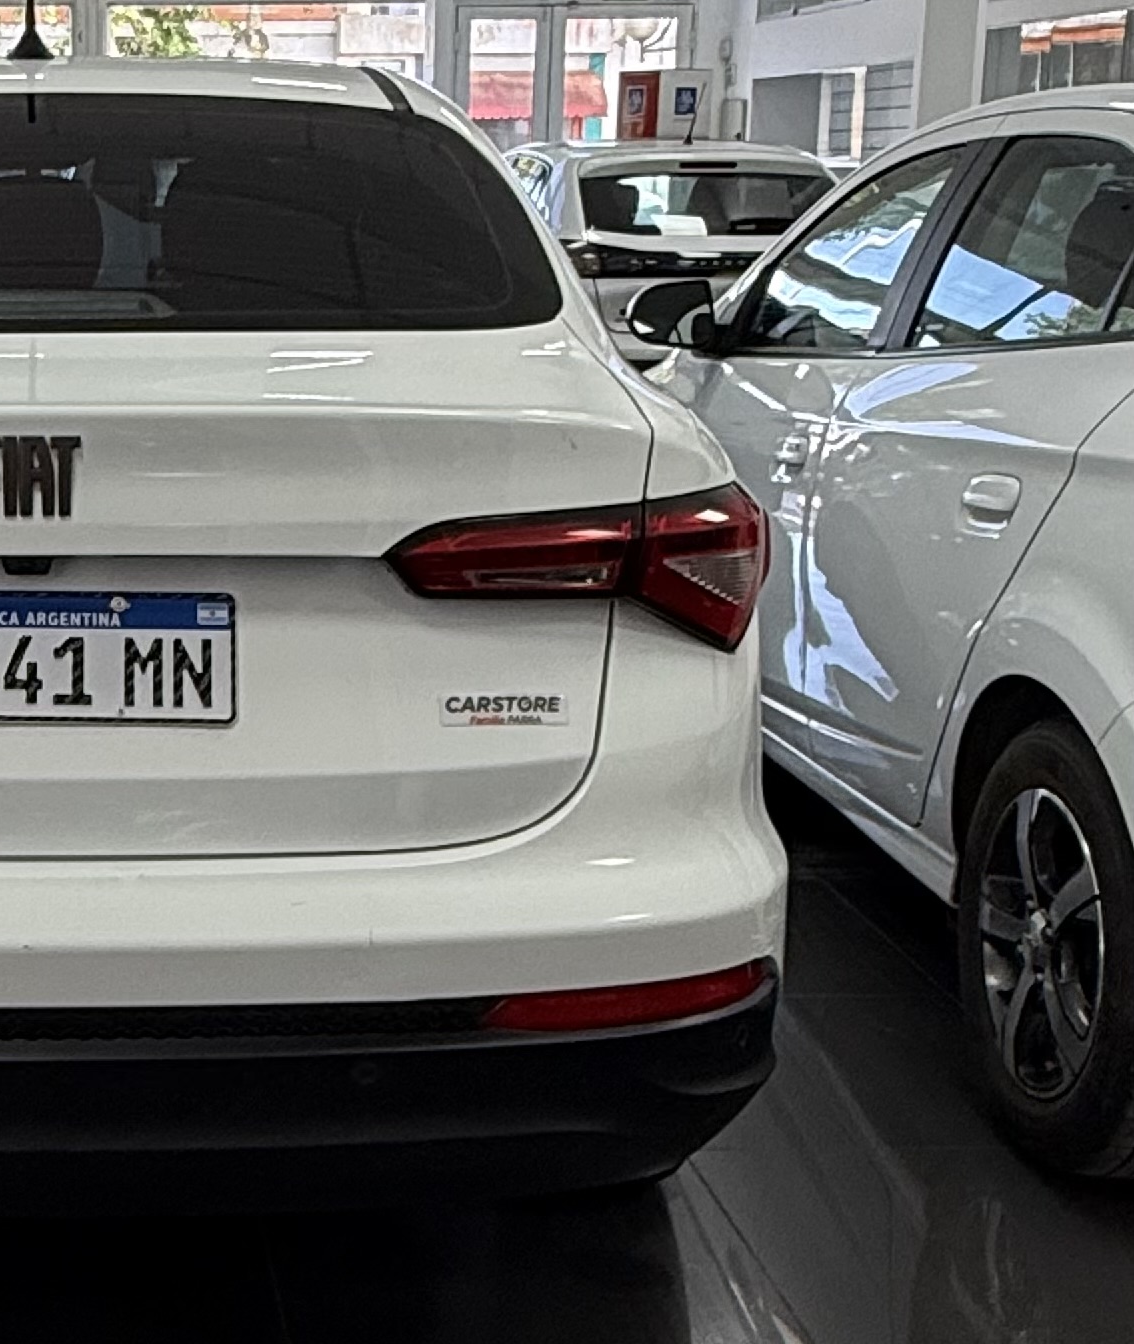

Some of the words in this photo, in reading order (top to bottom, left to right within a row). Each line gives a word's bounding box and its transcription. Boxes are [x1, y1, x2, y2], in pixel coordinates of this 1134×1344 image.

[25, 611, 121, 627] ARGENTINA
[123, 637, 213, 708] MN
[445, 696, 562, 713] CARSTORE
